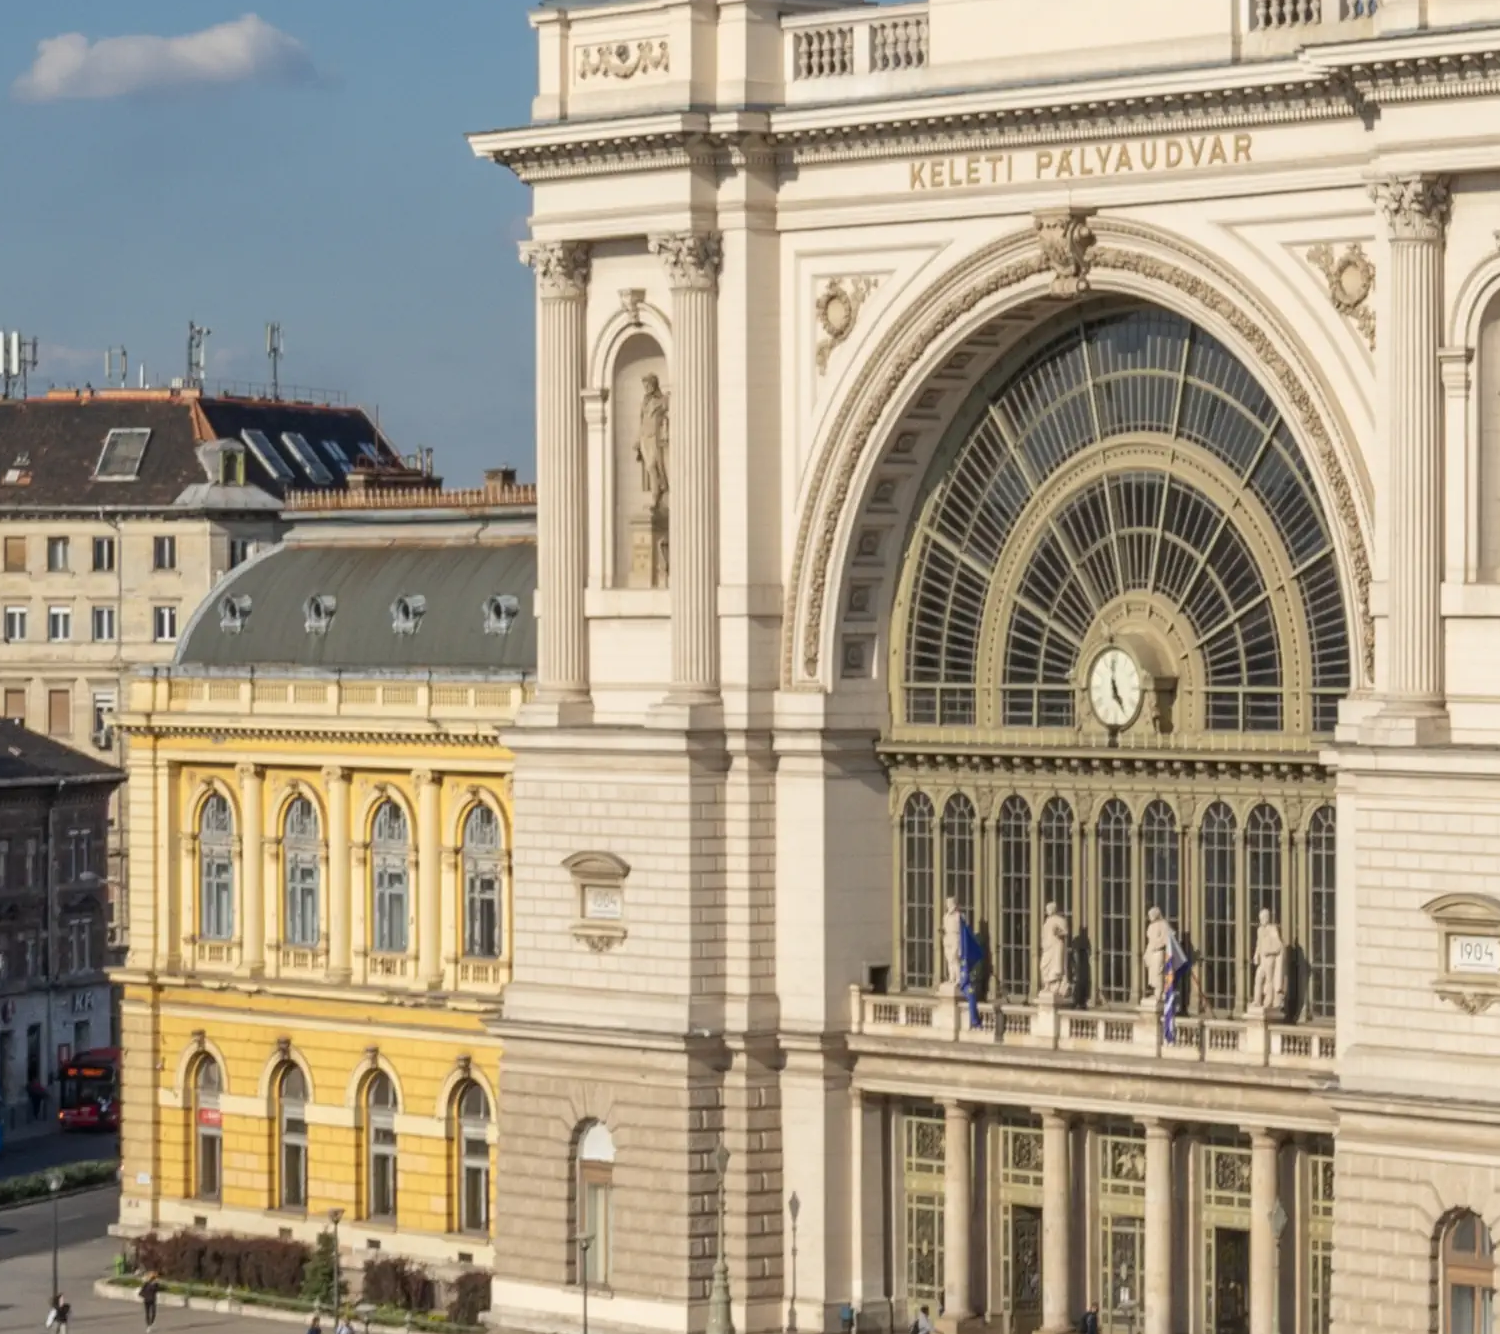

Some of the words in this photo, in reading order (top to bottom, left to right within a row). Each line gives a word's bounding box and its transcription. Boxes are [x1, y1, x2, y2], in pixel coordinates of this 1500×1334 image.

[909, 154, 1013, 191] KELETI
[1035, 133, 1253, 180] PÁLYAUDVAR
[1459, 942, 1494, 961] 1904
